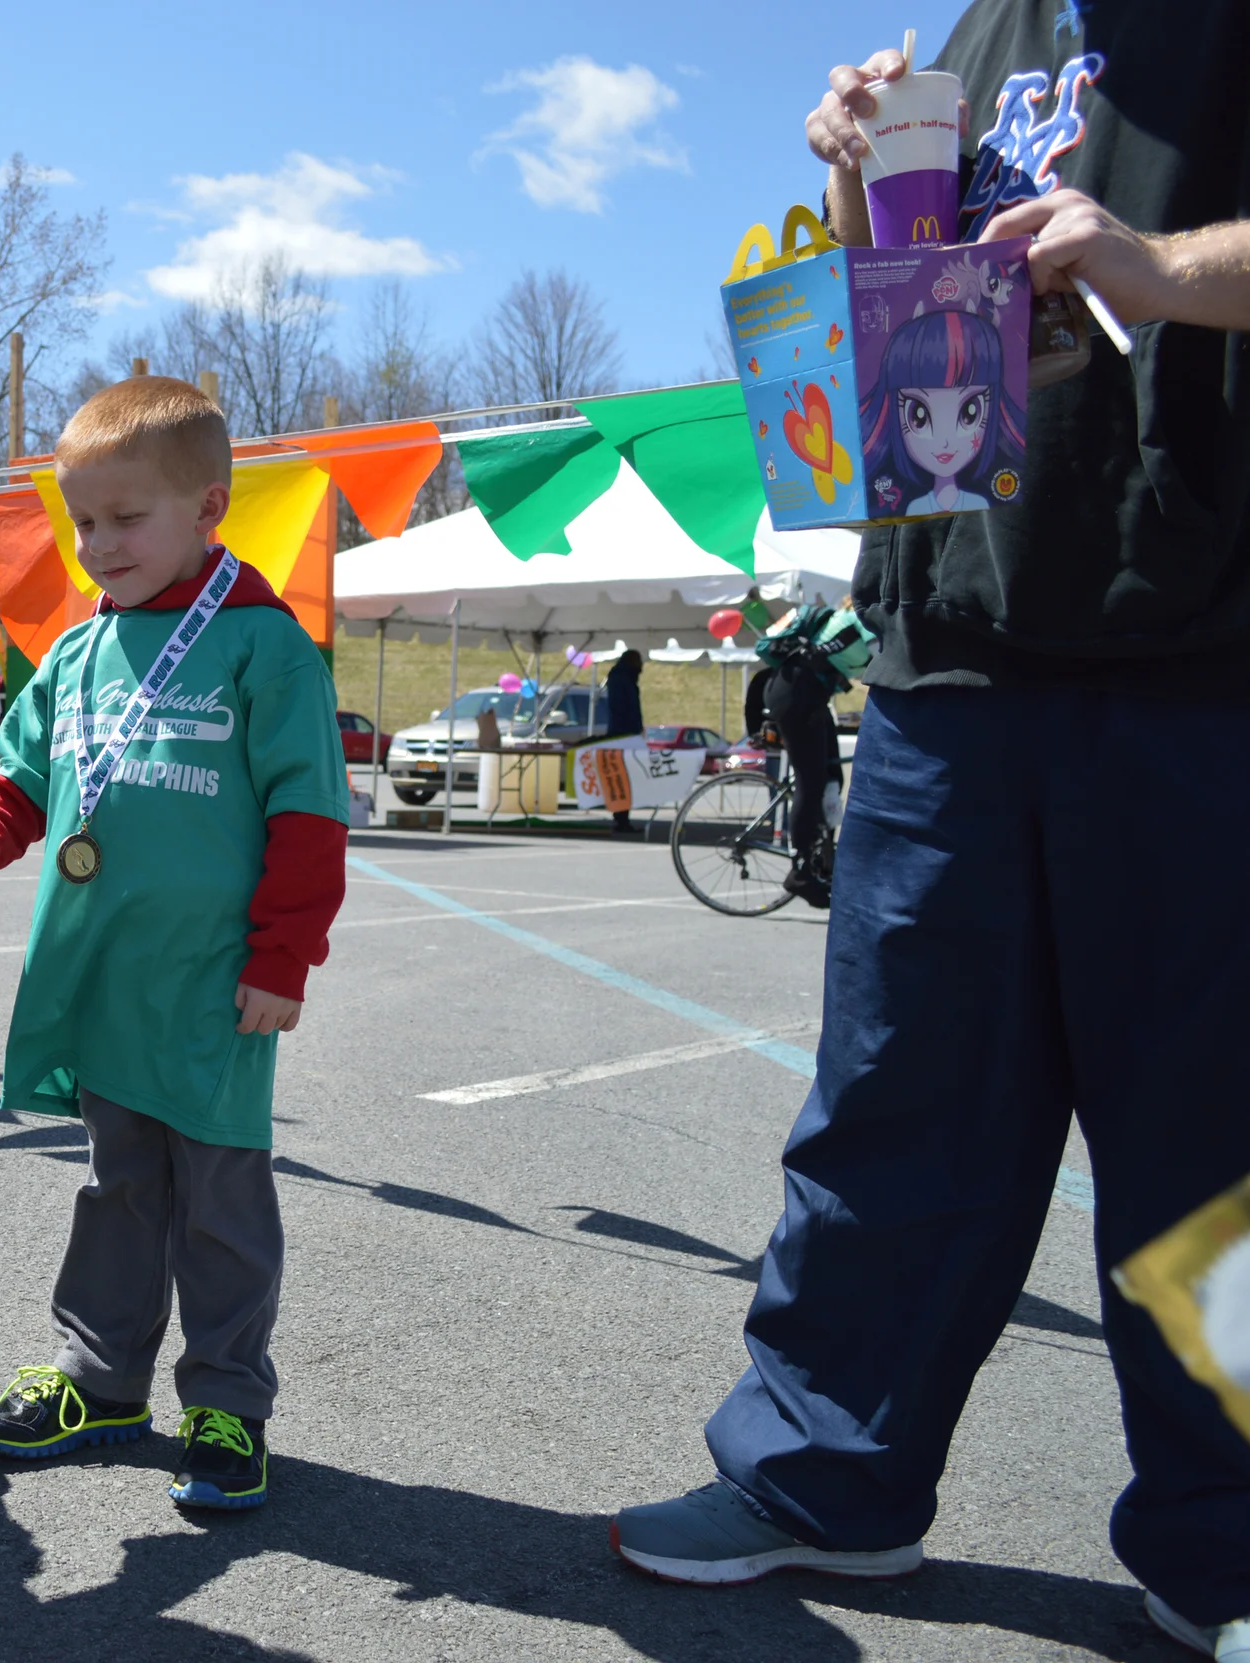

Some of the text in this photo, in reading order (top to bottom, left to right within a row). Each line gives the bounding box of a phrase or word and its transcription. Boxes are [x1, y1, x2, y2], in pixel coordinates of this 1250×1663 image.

[875, 125, 892, 138] half
[894, 121, 911, 132] full
[920, 119, 937, 128] half
[877, 260, 889, 268] fab
[734, 295, 806, 325] better with our
[207, 566, 233, 603] RUN
[177, 608, 207, 647] RUN
[147, 653, 175, 692] RUN
[95, 678, 225, 714] Grnbush
[83, 723, 112, 737] YOUTH
[160, 722, 198, 737] LEAGUE
[118, 700, 145, 740] RUN
[90, 749, 115, 789] RUN
[111, 757, 220, 797] DOLPHINS
